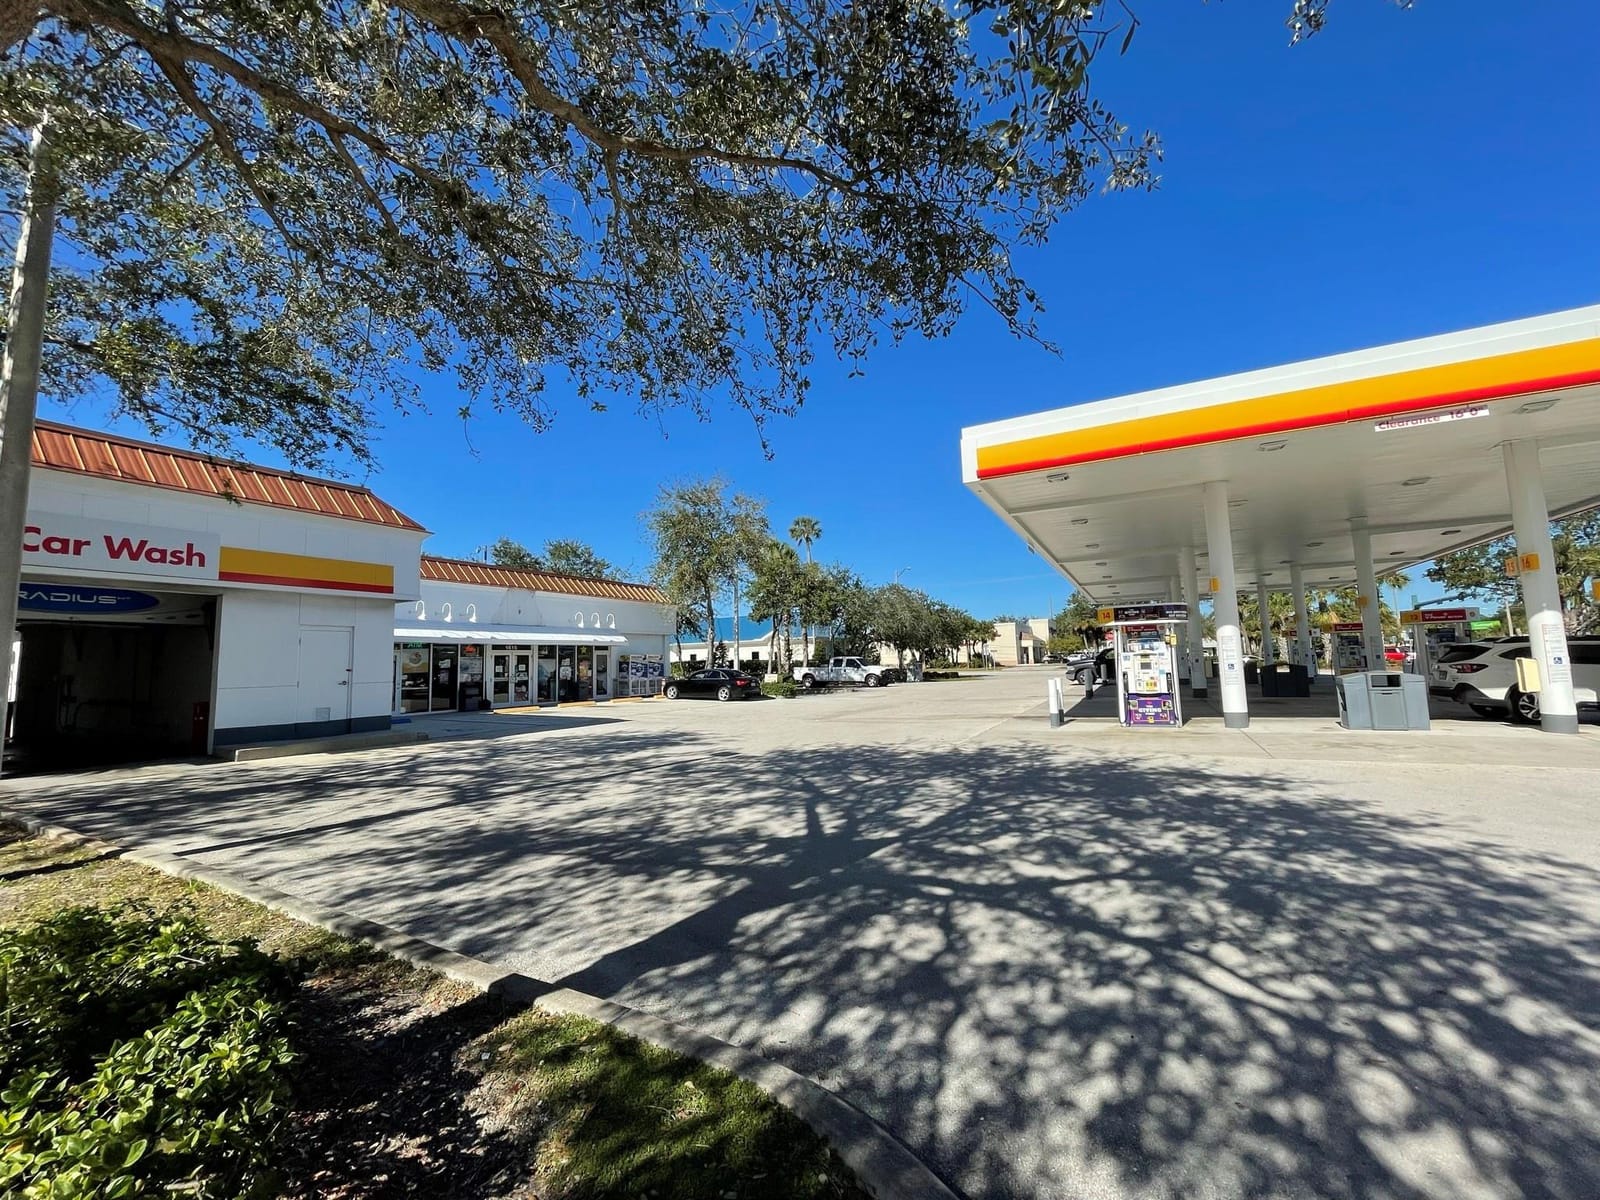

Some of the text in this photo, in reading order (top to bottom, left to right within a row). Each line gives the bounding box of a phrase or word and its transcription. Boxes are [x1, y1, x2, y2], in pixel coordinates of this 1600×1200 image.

[1379, 415, 1440, 430] Clearance
[23, 526, 206, 567] Car Wash
[1521, 556, 1531, 569] 16
[18, 590, 118, 605] RADIUS
[1102, 612, 1111, 620] 14
